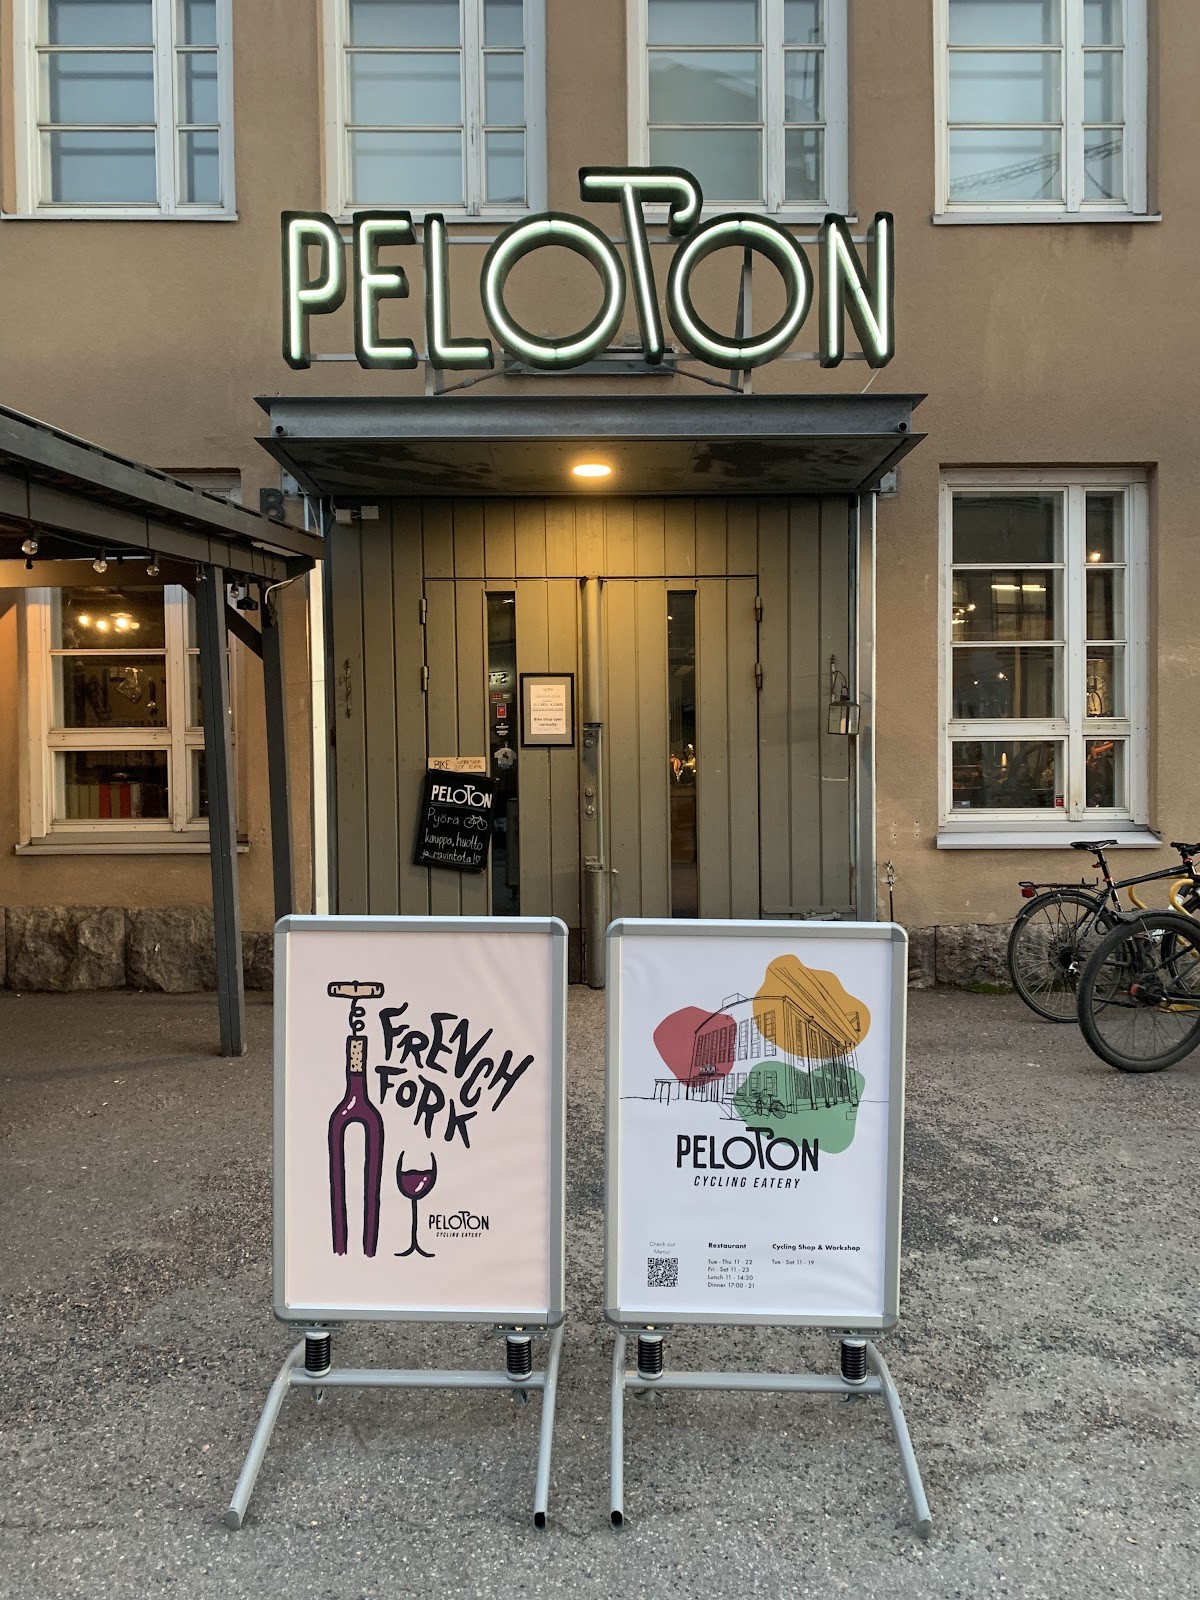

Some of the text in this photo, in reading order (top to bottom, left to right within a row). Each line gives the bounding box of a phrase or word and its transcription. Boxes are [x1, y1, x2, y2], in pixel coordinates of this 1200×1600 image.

[280, 166, 896, 370] PELOTON
[260, 488, 286, 521] B
[434, 760, 450, 770] BIKE
[431, 784, 492, 808] PELOTON
[428, 807, 460, 828] Pyörä
[456, 832, 483, 850] huolto
[378, 1002, 534, 1112] FRENCH
[375, 1065, 478, 1148] FORK
[677, 1126, 819, 1172] PELOTON
[694, 1176, 800, 1189] CYCLING EATERY
[428, 1210, 490, 1230] PELOTON
